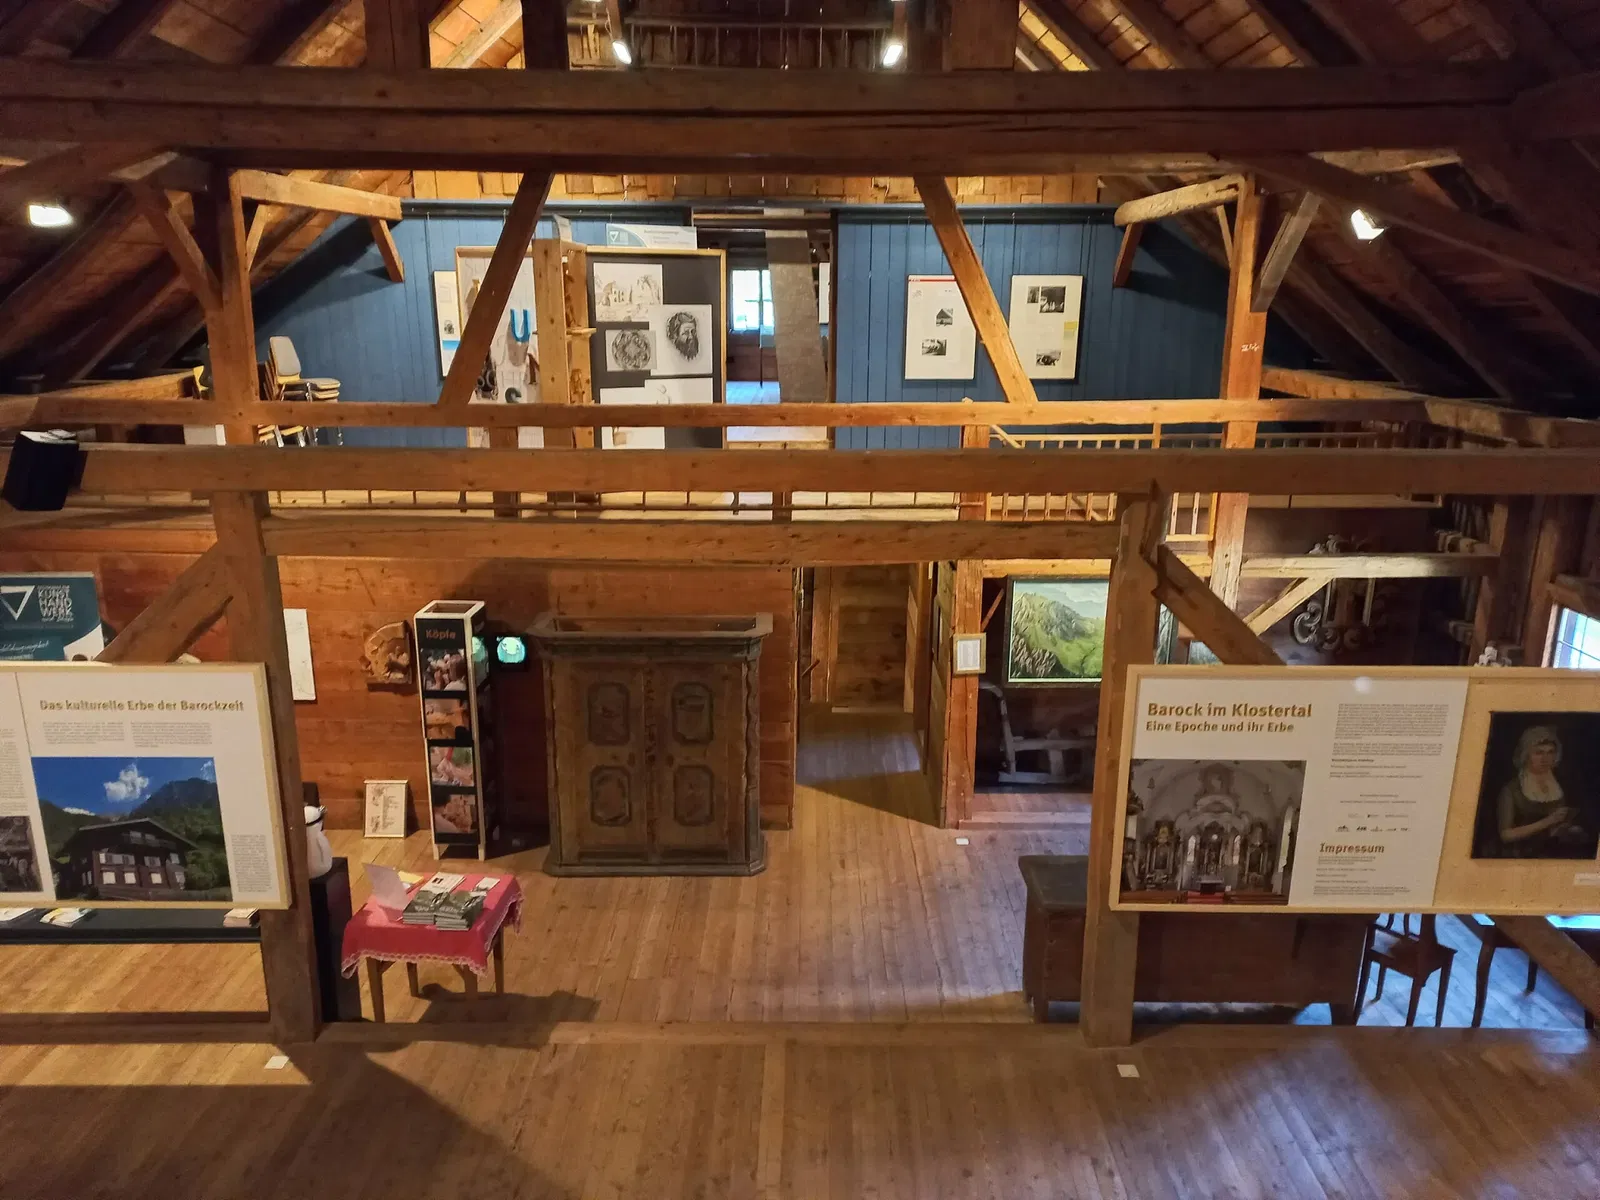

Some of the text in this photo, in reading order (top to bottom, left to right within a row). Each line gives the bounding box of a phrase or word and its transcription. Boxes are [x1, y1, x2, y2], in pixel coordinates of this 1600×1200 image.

[38, 589, 70, 599] KUNST
[39, 598, 73, 608] HAND
[41, 606, 73, 617] WERK
[426, 628, 456, 640] Köpfe
[40, 700, 244, 711] Das kulturelle Erbe der Barockzeit
[1148, 703, 1312, 718] Barock im Klostertal
[1146, 721, 1294, 734] Eine Epoche und ihr Erbe
[1319, 843, 1385, 854] Impressum
